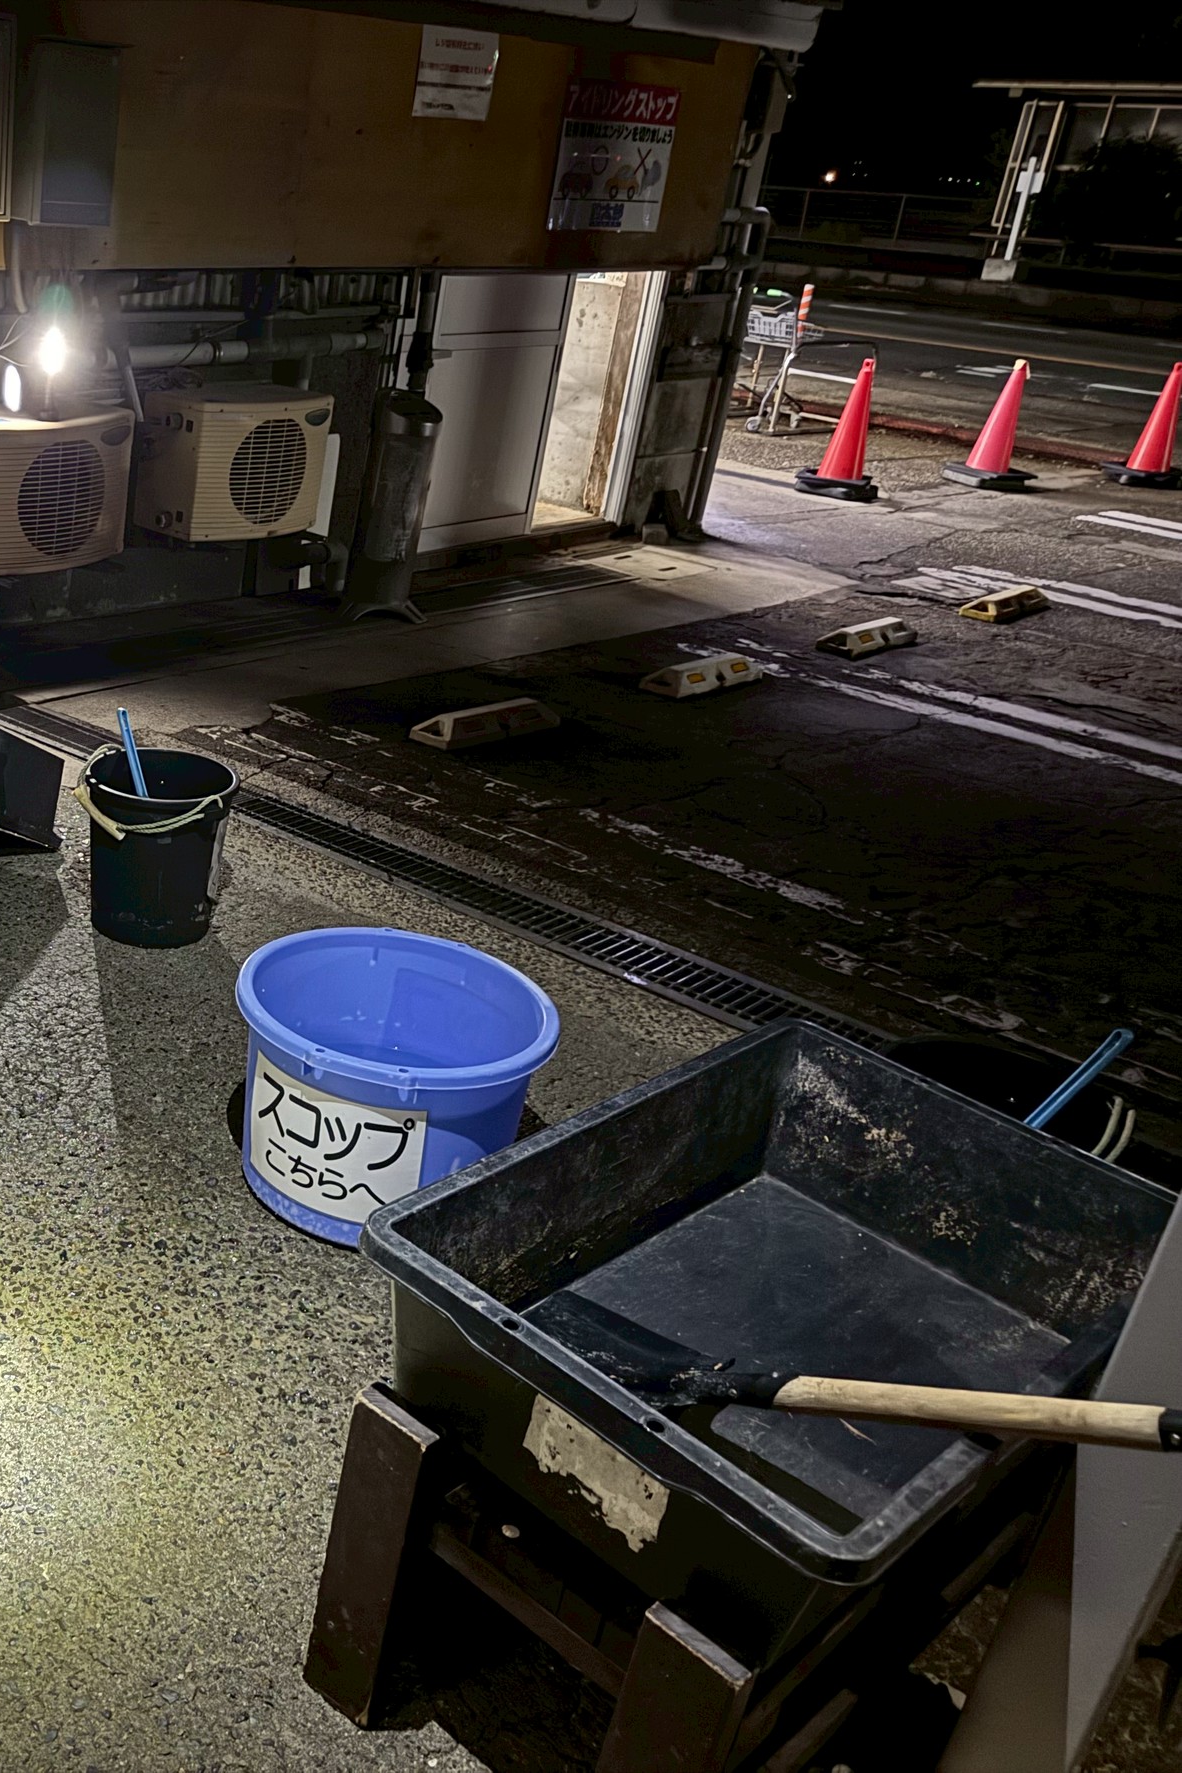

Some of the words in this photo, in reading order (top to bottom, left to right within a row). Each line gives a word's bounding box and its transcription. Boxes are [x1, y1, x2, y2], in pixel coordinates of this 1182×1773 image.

[568, 84, 679, 121] アイドリングストップ
[258, 1072, 415, 1170] スコップ
[266, 1138, 386, 1205] こちらへ
